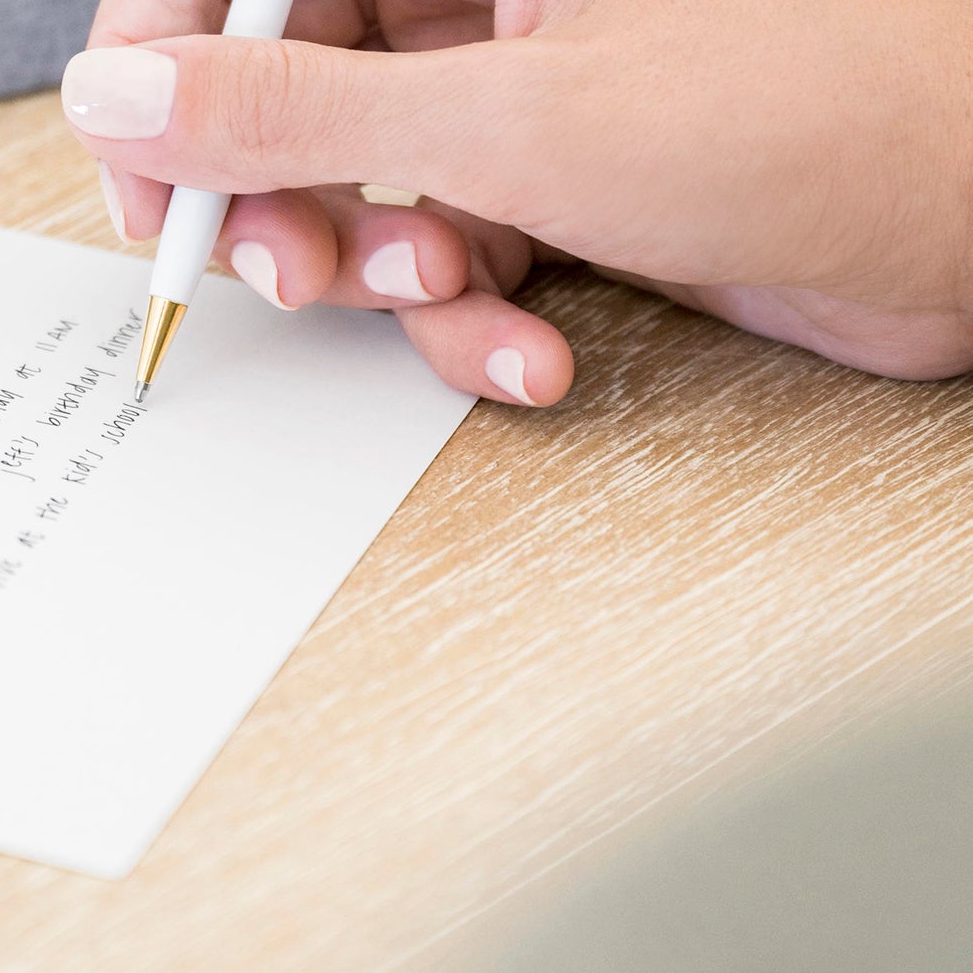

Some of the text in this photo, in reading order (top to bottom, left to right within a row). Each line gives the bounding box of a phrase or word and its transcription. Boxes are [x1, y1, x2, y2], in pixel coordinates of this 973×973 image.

[45, 318, 79, 342] AM
[33, 340, 58, 353] 11
[13, 362, 42, 380] at
[34, 365, 116, 427] birthday
[95, 307, 143, 358] dinner
[15, 529, 46, 549] at
[35, 495, 69, 521] the
[60, 447, 104, 485] kid's
[99, 401, 148, 445] school
